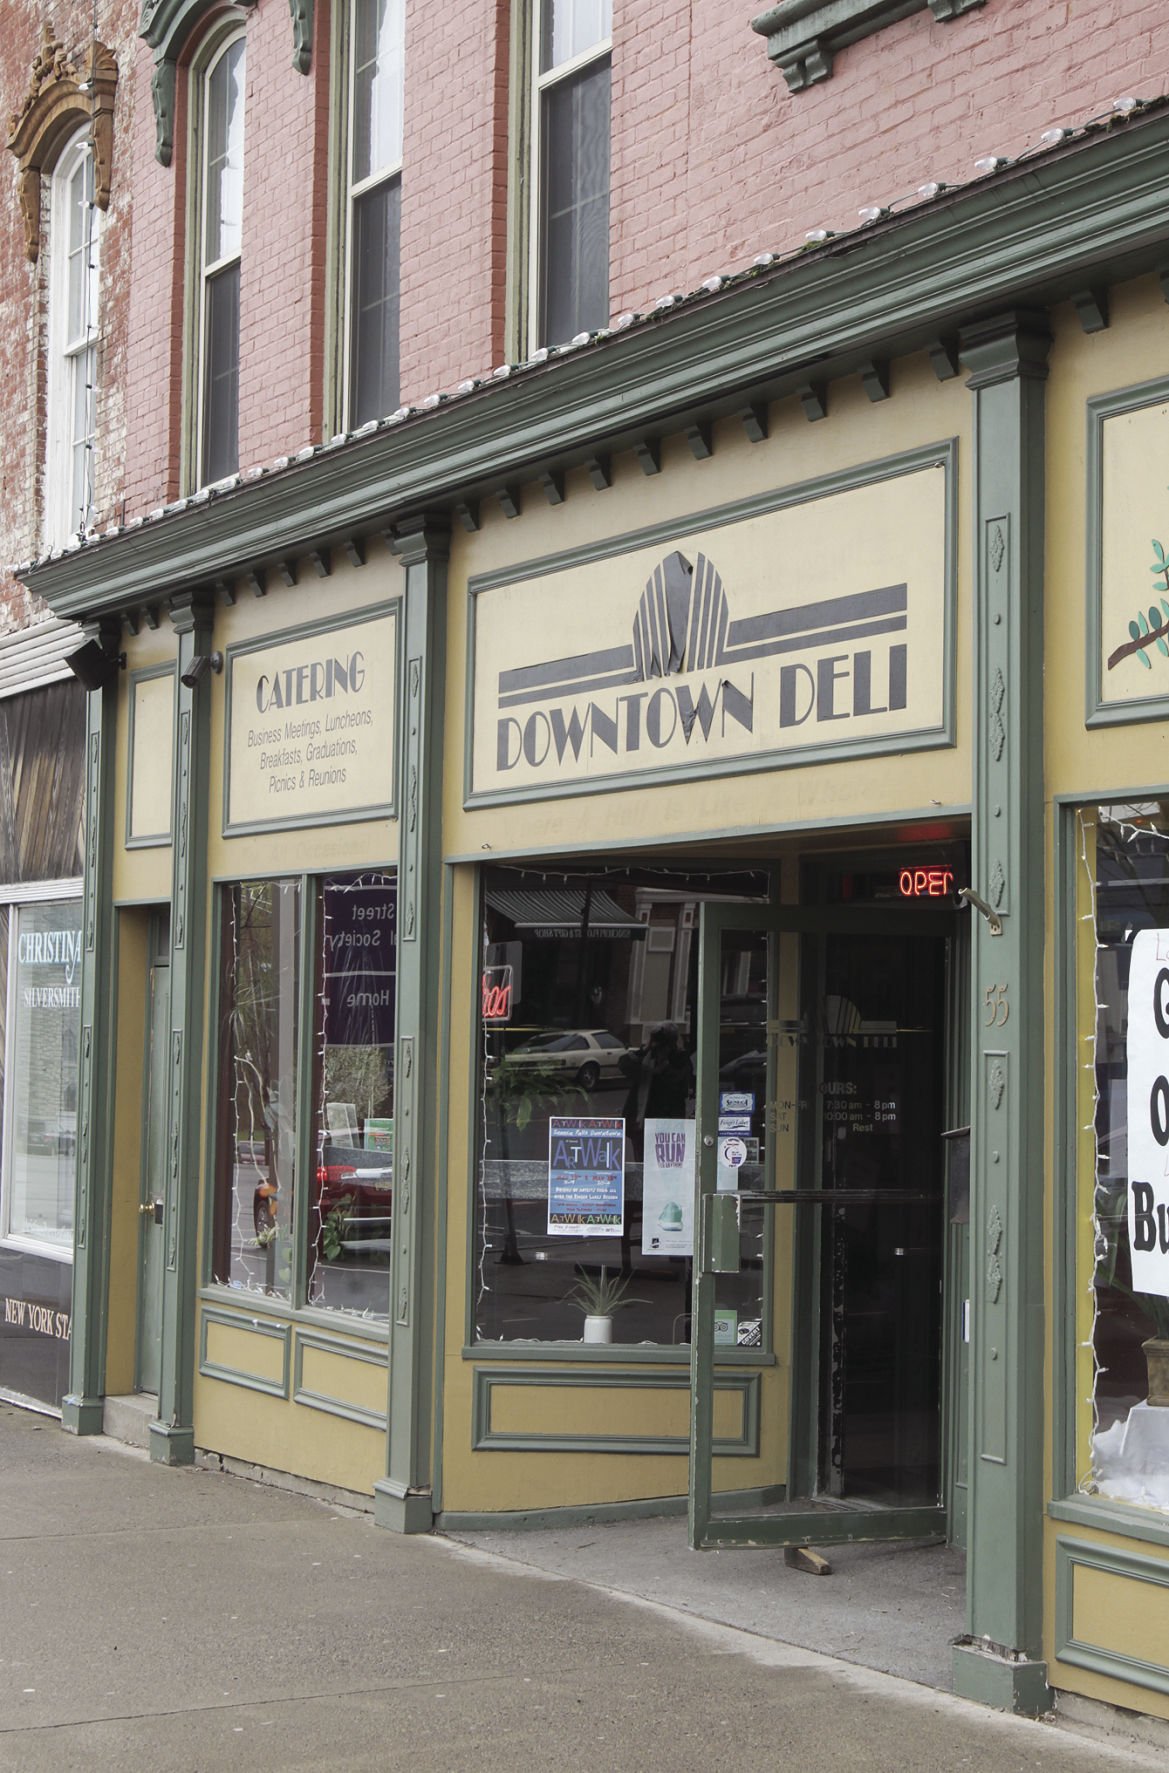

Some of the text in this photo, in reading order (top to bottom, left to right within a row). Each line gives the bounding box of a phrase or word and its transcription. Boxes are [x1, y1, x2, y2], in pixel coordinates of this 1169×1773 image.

[256, 651, 366, 714] CATERING
[496, 643, 908, 772] DOWNTOWN DELI
[247, 709, 373, 748] Business Meetings, Luncheons,
[260, 737, 358, 770] Breakfasts, Graduations,
[268, 765, 347, 793] Picnics & Reunions
[984, 983, 1009, 1028] 55
[818, 1081, 858, 1095] OURS:
[873, 1099, 881, 1110] 8
[882, 1101, 896, 1111] pm
[874, 1111, 881, 1121] 8
[882, 1113, 897, 1122] pm
[654, 1132, 686, 1143] YOU CAN
[655, 1143, 686, 1163] RUN
[5, 1297, 26, 1326] NEW
[28, 1303, 55, 1336] YORK
